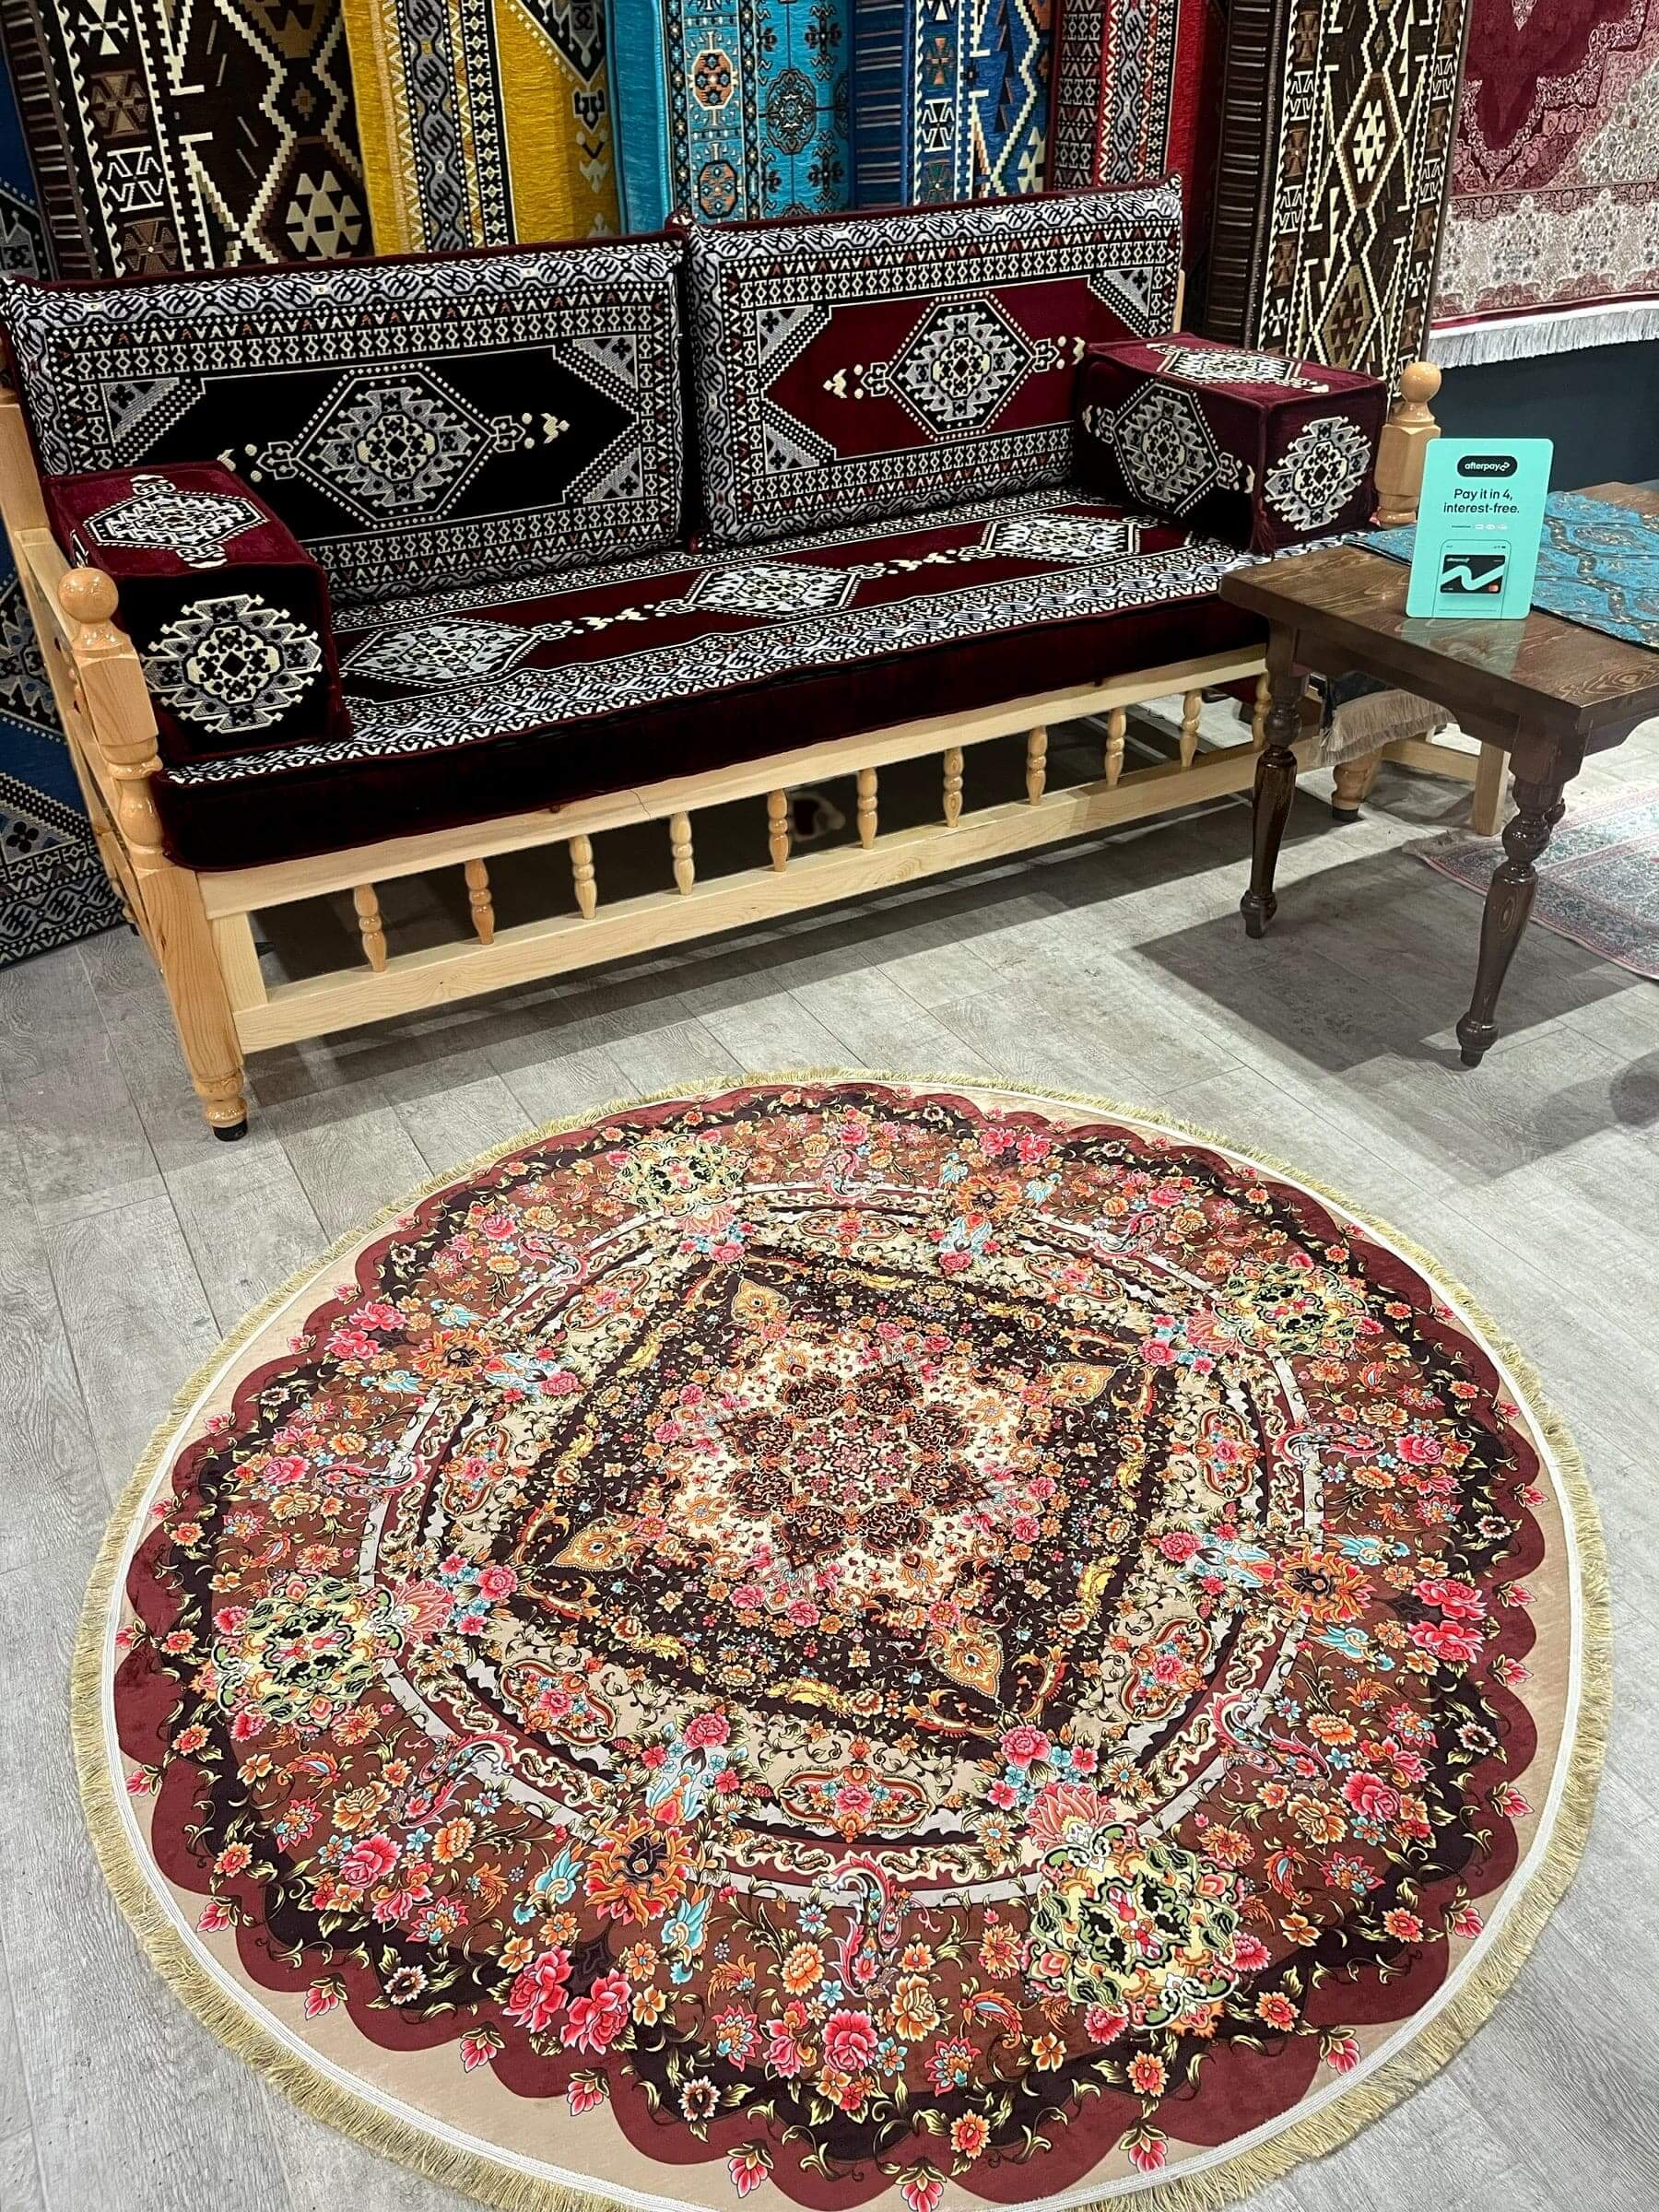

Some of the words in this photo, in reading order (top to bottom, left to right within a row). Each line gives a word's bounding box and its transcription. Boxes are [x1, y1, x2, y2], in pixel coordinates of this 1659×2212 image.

[1465, 462, 1500, 472] afterpay
[1453, 488, 1477, 501] Pay
[1479, 488, 1488, 500] it
[1489, 488, 1500, 500] in
[1502, 488, 1513, 501] 4,
[1443, 502, 1520, 513] interest-free.
